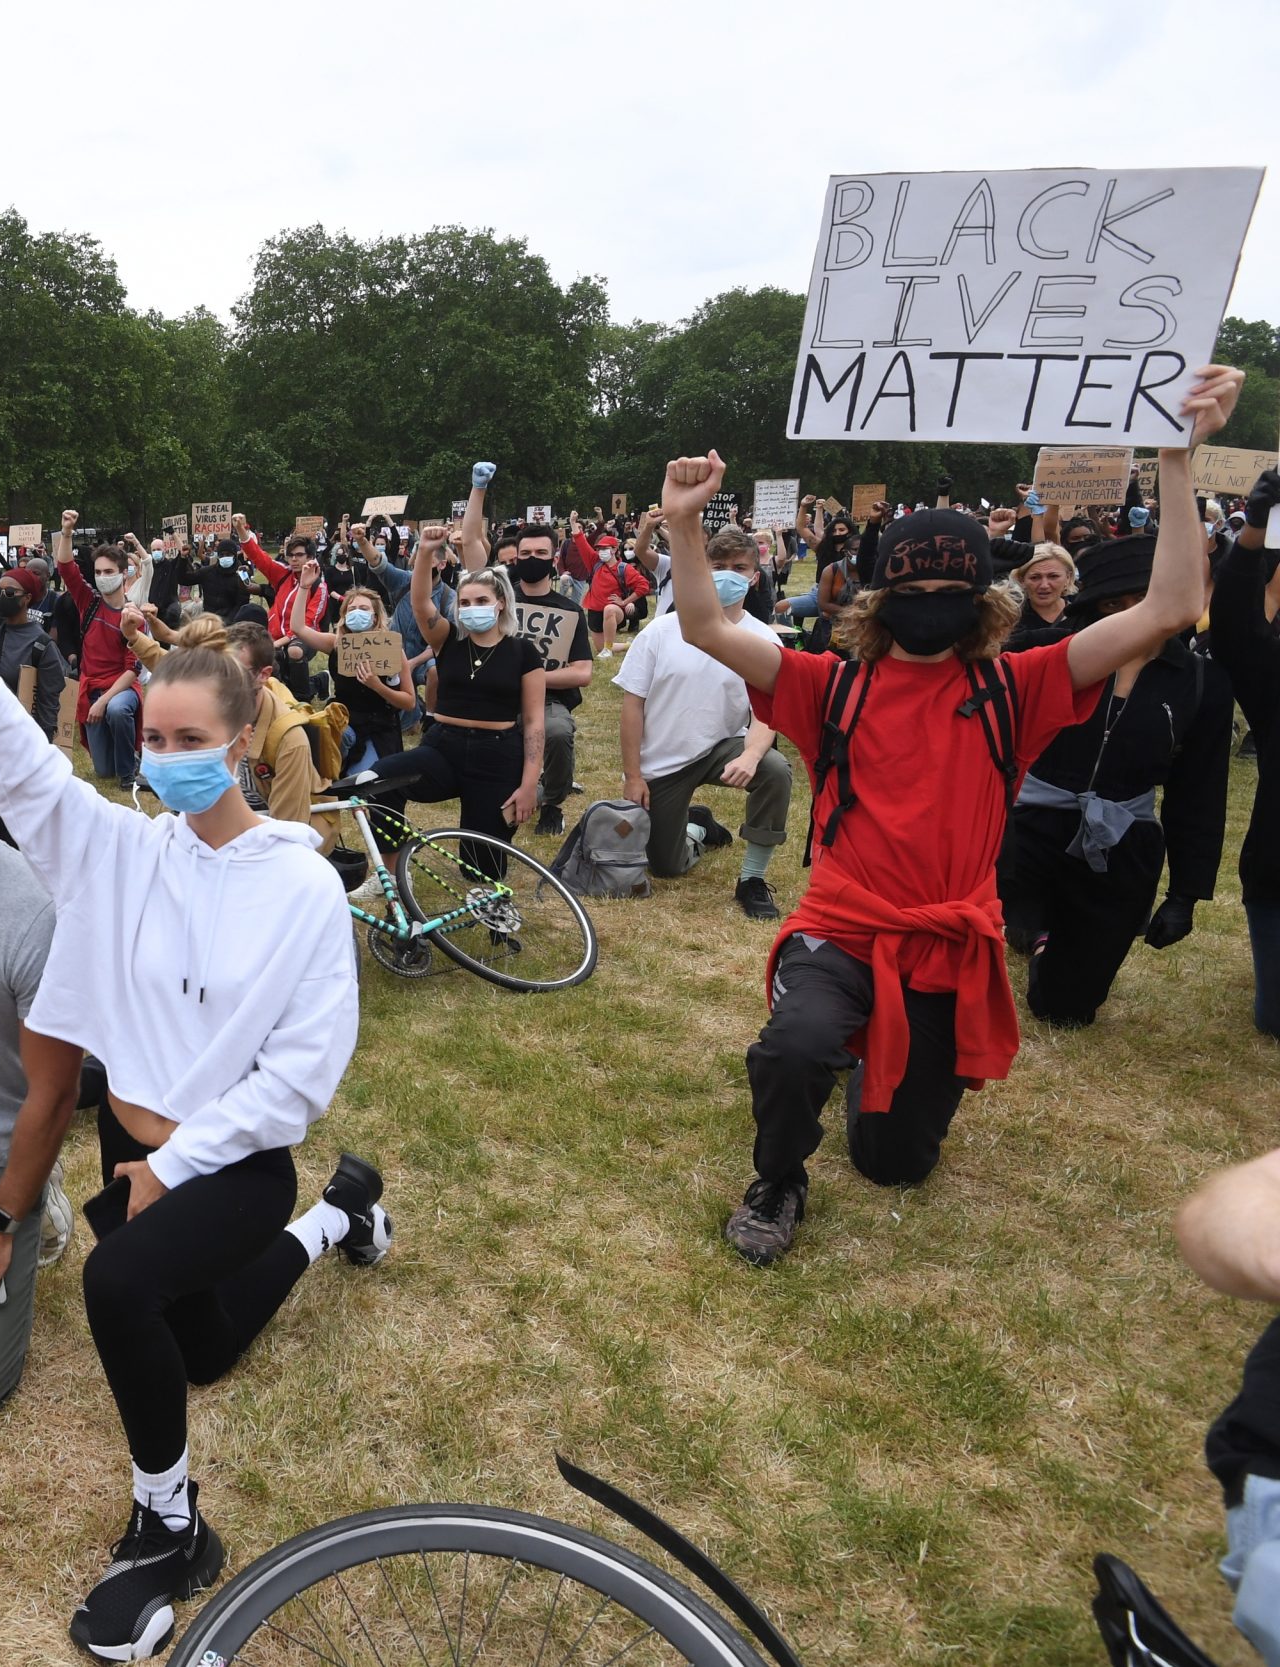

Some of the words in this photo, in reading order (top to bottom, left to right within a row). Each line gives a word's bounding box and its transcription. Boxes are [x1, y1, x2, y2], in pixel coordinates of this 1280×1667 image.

[824, 178, 1175, 271] BLACK
[810, 271, 1182, 348] LIVES
[794, 350, 1186, 434] MATTER
[1201, 452, 1240, 469] THE
[1140, 463, 1158, 472] ACK
[1040, 478, 1122, 489] #BLACKLIVESMATTER
[1194, 471, 1220, 486] WILL
[1226, 475, 1252, 488] NOT
[712, 493, 735, 501] STOP
[1038, 488, 1123, 500] #ICAN'TBREATHE
[195, 505, 209, 514] THE
[211, 504, 230, 513] REAL
[707, 503, 739, 511] KILLING
[195, 514, 217, 523] VIRUS
[220, 514, 227, 522] IS
[707, 510, 731, 519] BLAC
[194, 523, 231, 533] RACISM
[704, 519, 730, 528] PEOP
[890, 538, 933, 557] Six
[933, 535, 966, 553] Feet
[341, 636, 392, 650] BLACK
[342, 652, 372, 661] LIVES
[344, 659, 392, 672] MAER
